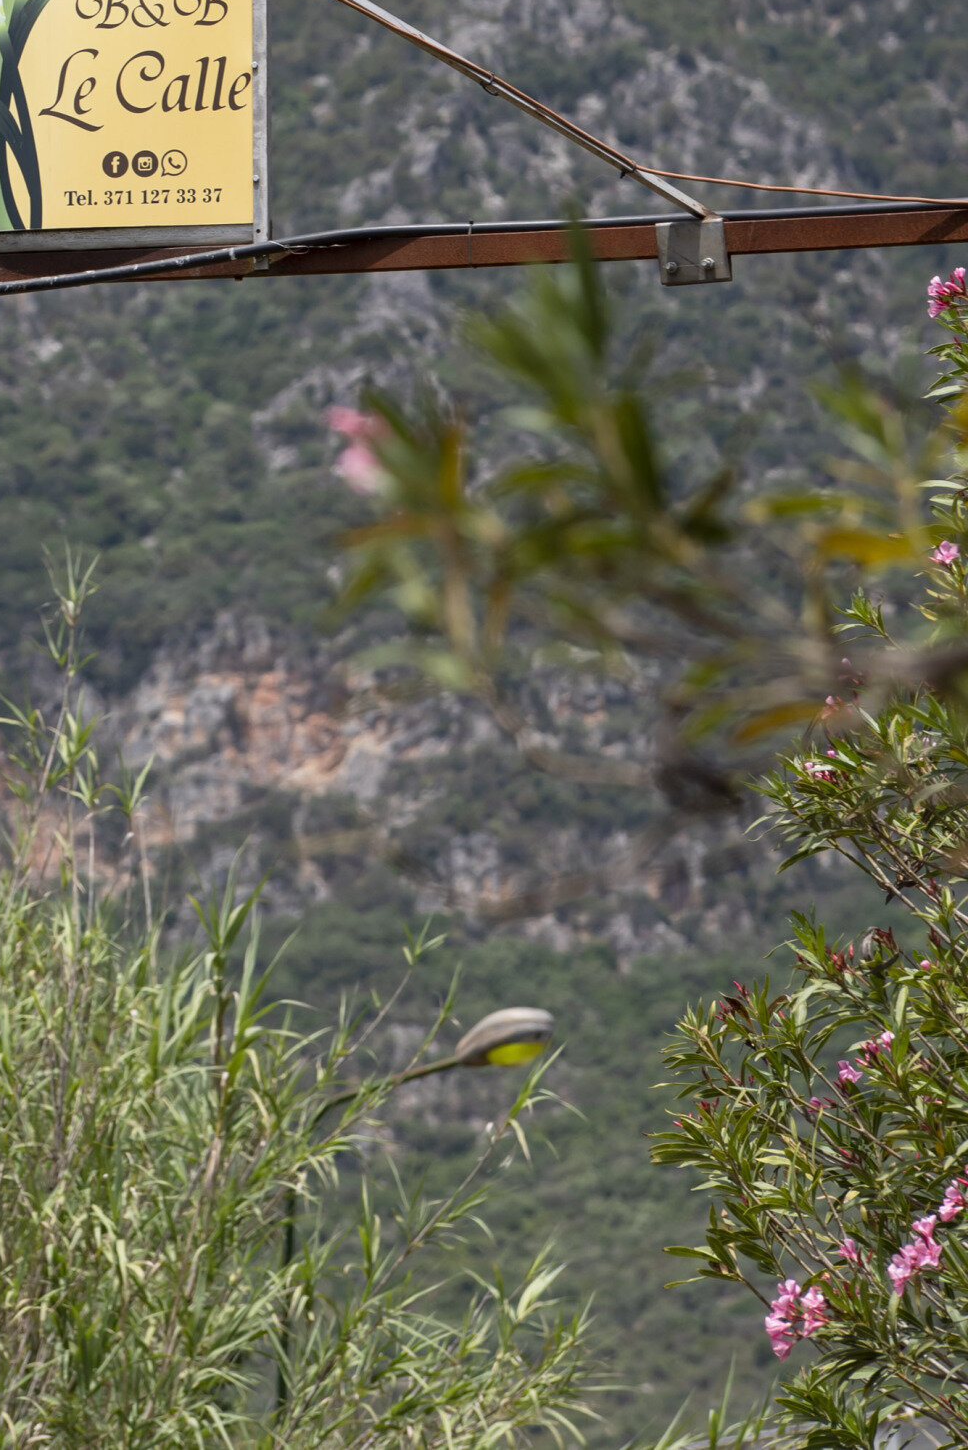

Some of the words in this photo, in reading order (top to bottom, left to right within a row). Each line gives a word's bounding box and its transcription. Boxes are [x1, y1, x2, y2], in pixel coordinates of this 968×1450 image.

[37, 48, 105, 132] Le
[116, 50, 252, 114] Calle
[64, 190, 98, 206] Tel.
[103, 190, 134, 206] 371
[140, 189, 171, 205] 127
[176, 188, 197, 204] 33
[202, 188, 223, 203] 37
